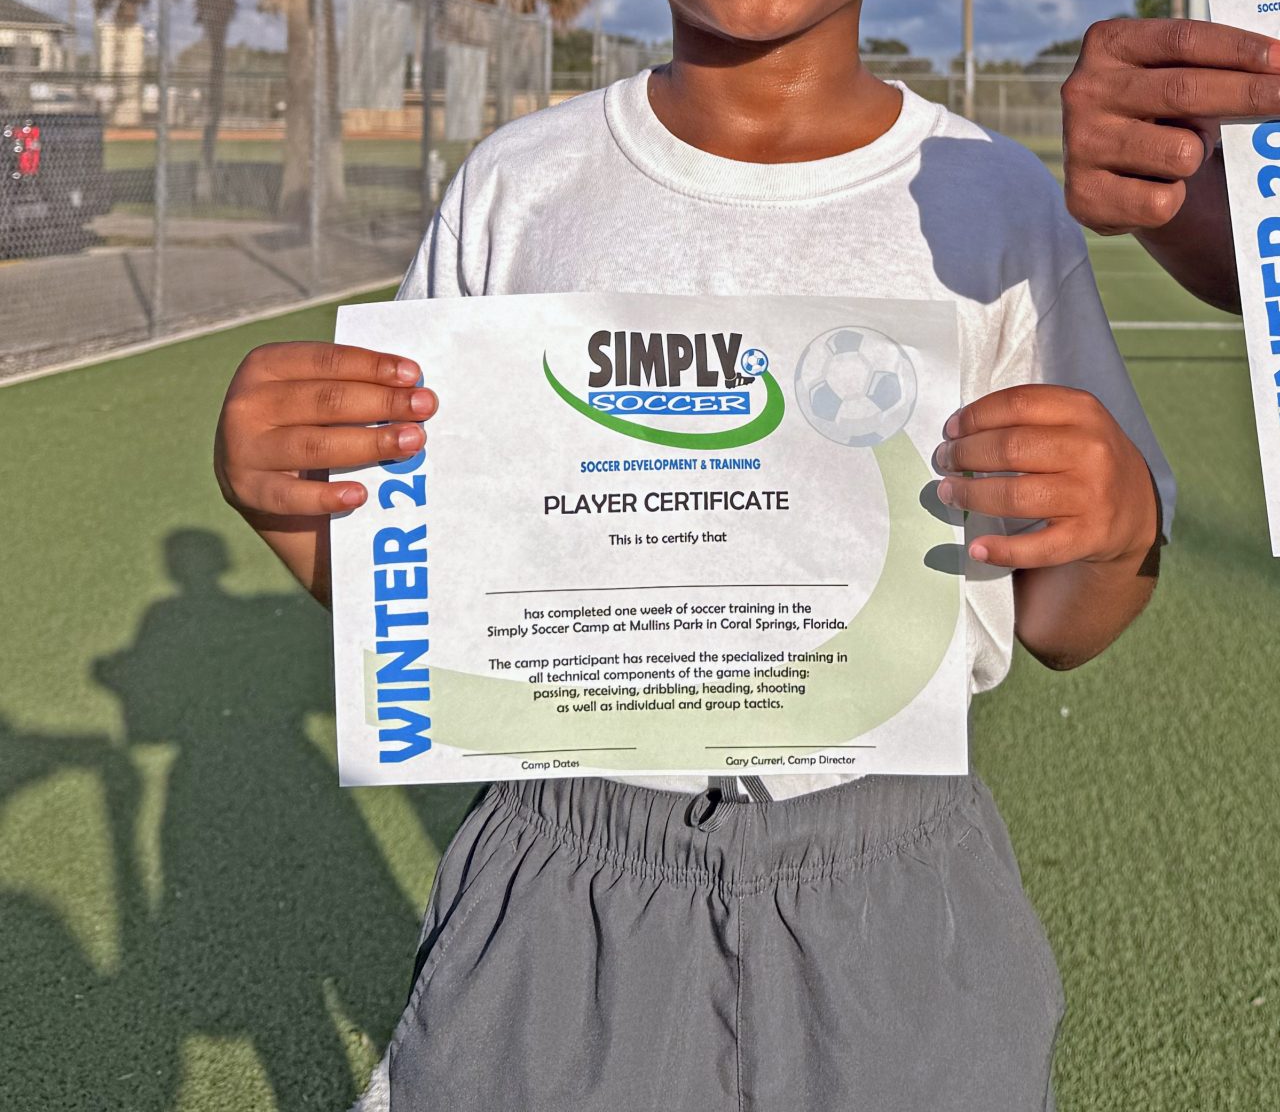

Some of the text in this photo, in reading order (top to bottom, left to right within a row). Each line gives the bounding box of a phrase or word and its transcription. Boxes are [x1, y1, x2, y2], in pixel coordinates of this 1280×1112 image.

[588, 329, 743, 389] SIMPLY
[592, 394, 747, 412] SOCCER
[581, 458, 761, 473] SOCCER DEVELOPMENT & TRAINING
[544, 491, 789, 515] PLAYER CERTIFICATE
[609, 531, 727, 545] This is to certify that
[524, 602, 811, 620] has completed one week of soccer training in the
[487, 618, 847, 638] Simply Soccer Camp at Mullins Park in Coral Springs, Florida.
[373, 523, 432, 764] WINTER
[488, 651, 847, 670] The camp participant has received the specialized training in
[529, 666, 809, 684] all technical components of the game including:
[534, 682, 805, 701] passing, receiving, dribbling, heading, shooting
[557, 698, 783, 713] as well as individual and group tactics.
[521, 759, 580, 770] Camp Dates
[726, 755, 856, 767] Gary Curreri, Camp Director
